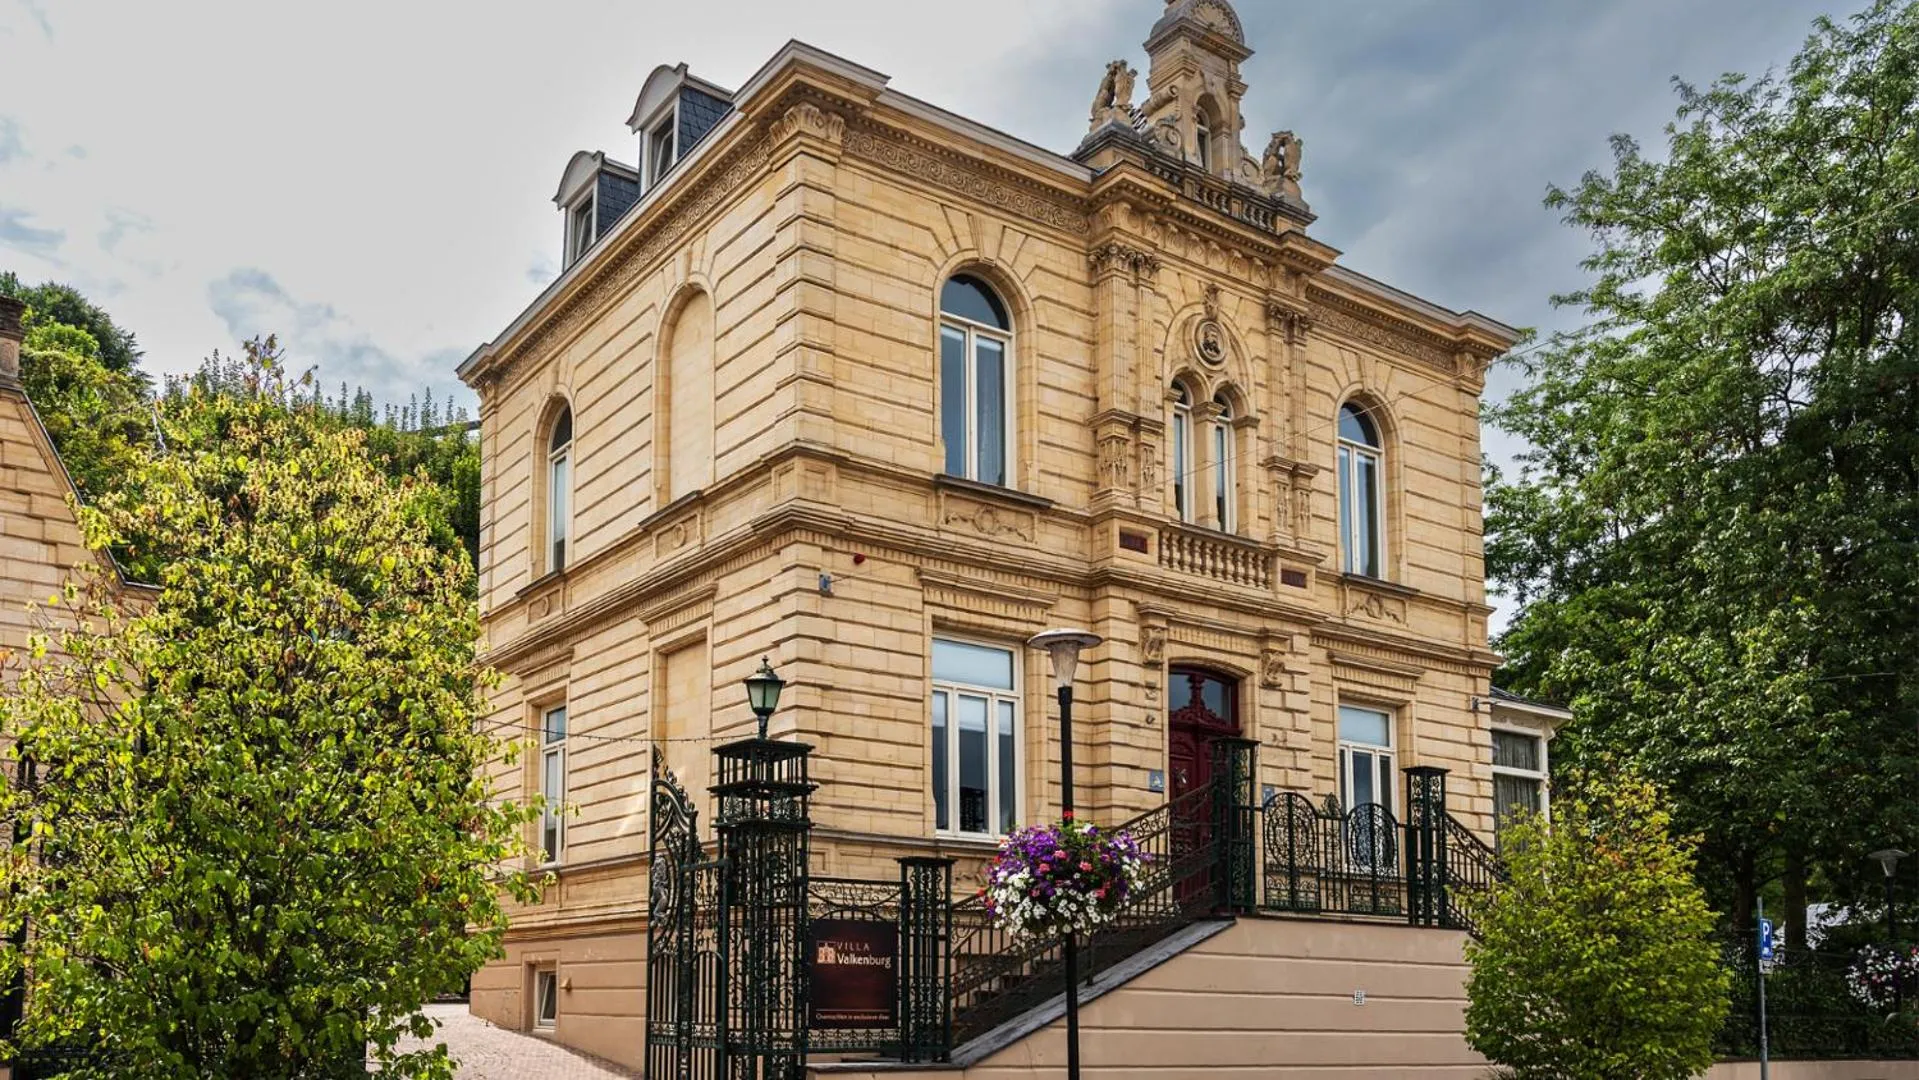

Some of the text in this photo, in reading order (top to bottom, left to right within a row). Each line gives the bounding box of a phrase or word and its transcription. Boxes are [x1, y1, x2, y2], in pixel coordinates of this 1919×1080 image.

[1762, 922, 1769, 942] P
[837, 941, 870, 951] VILLA
[837, 953, 891, 969] Valkenburg
